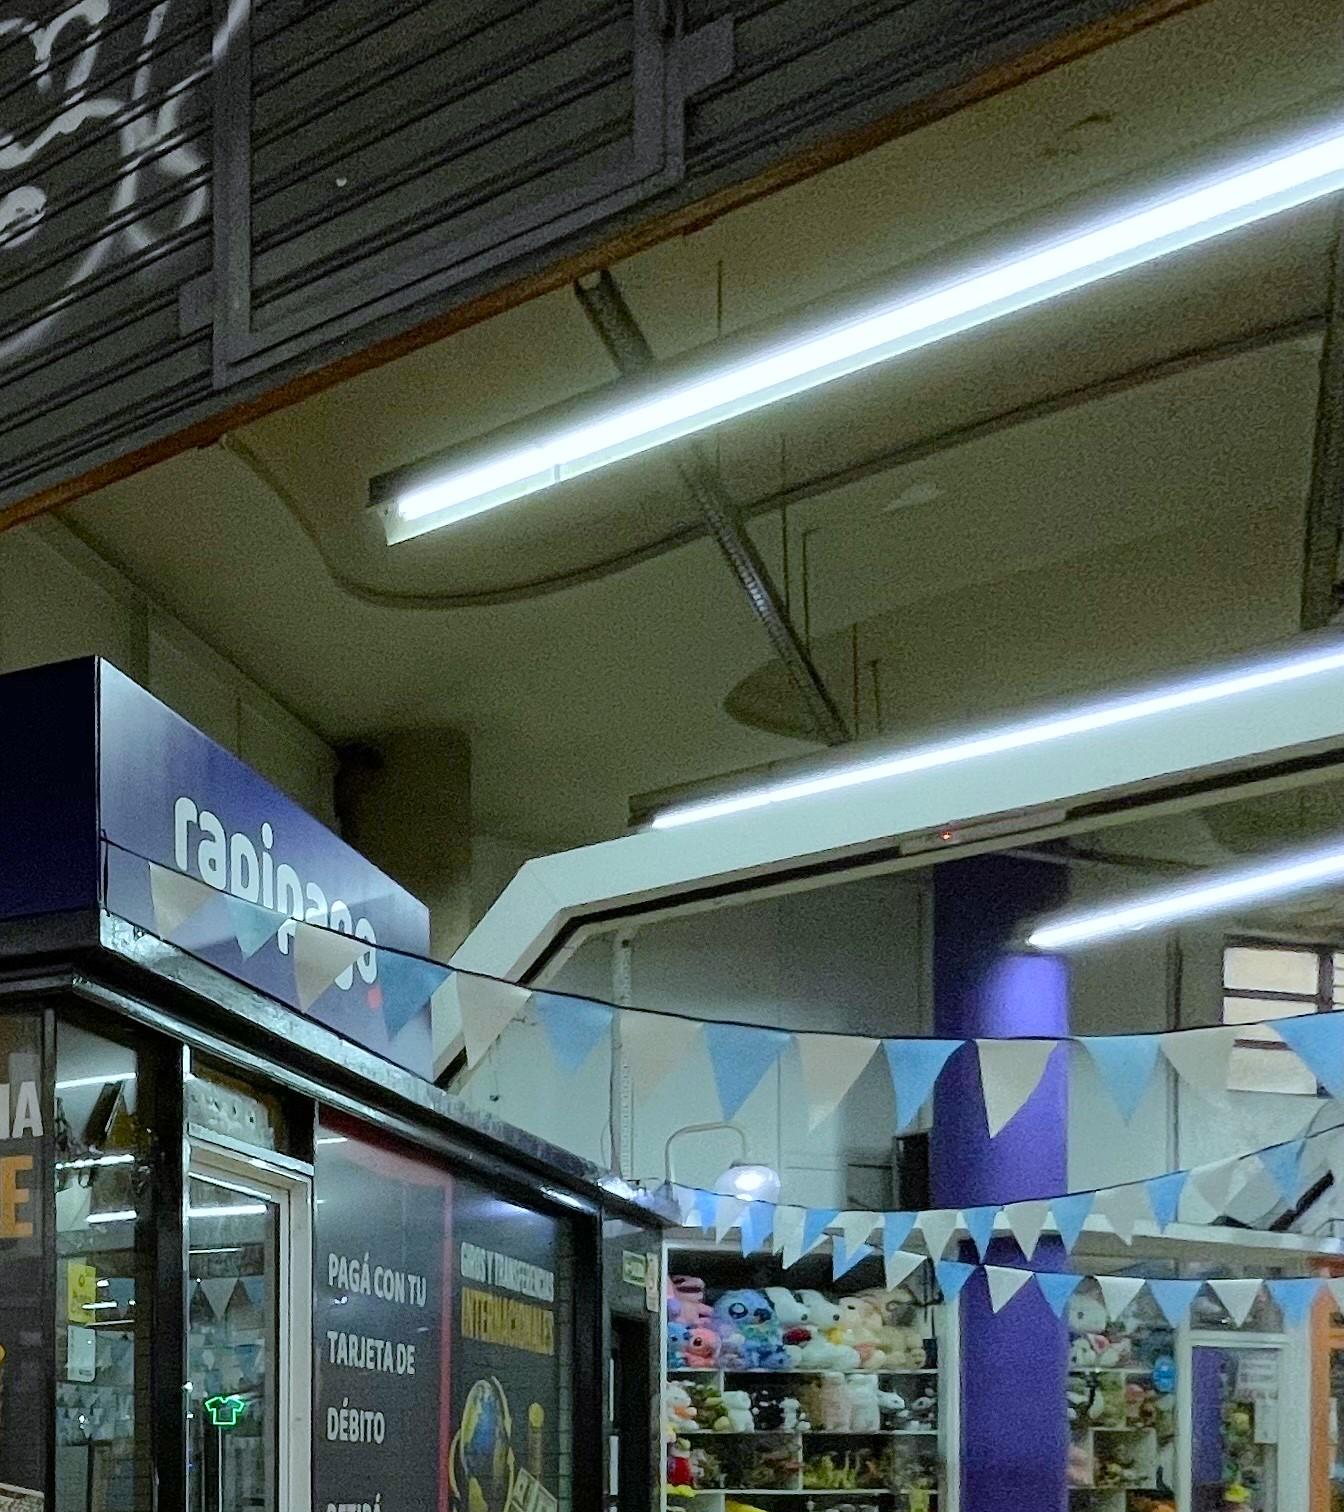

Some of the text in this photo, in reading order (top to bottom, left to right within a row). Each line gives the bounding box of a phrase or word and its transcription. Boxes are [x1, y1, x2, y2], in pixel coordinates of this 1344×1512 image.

[328, 1252, 427, 1307] PAGÁ CON TU
[327, 1330, 416, 1375] TARJETA DE
[326, 1397, 385, 1444] DÉBITO
